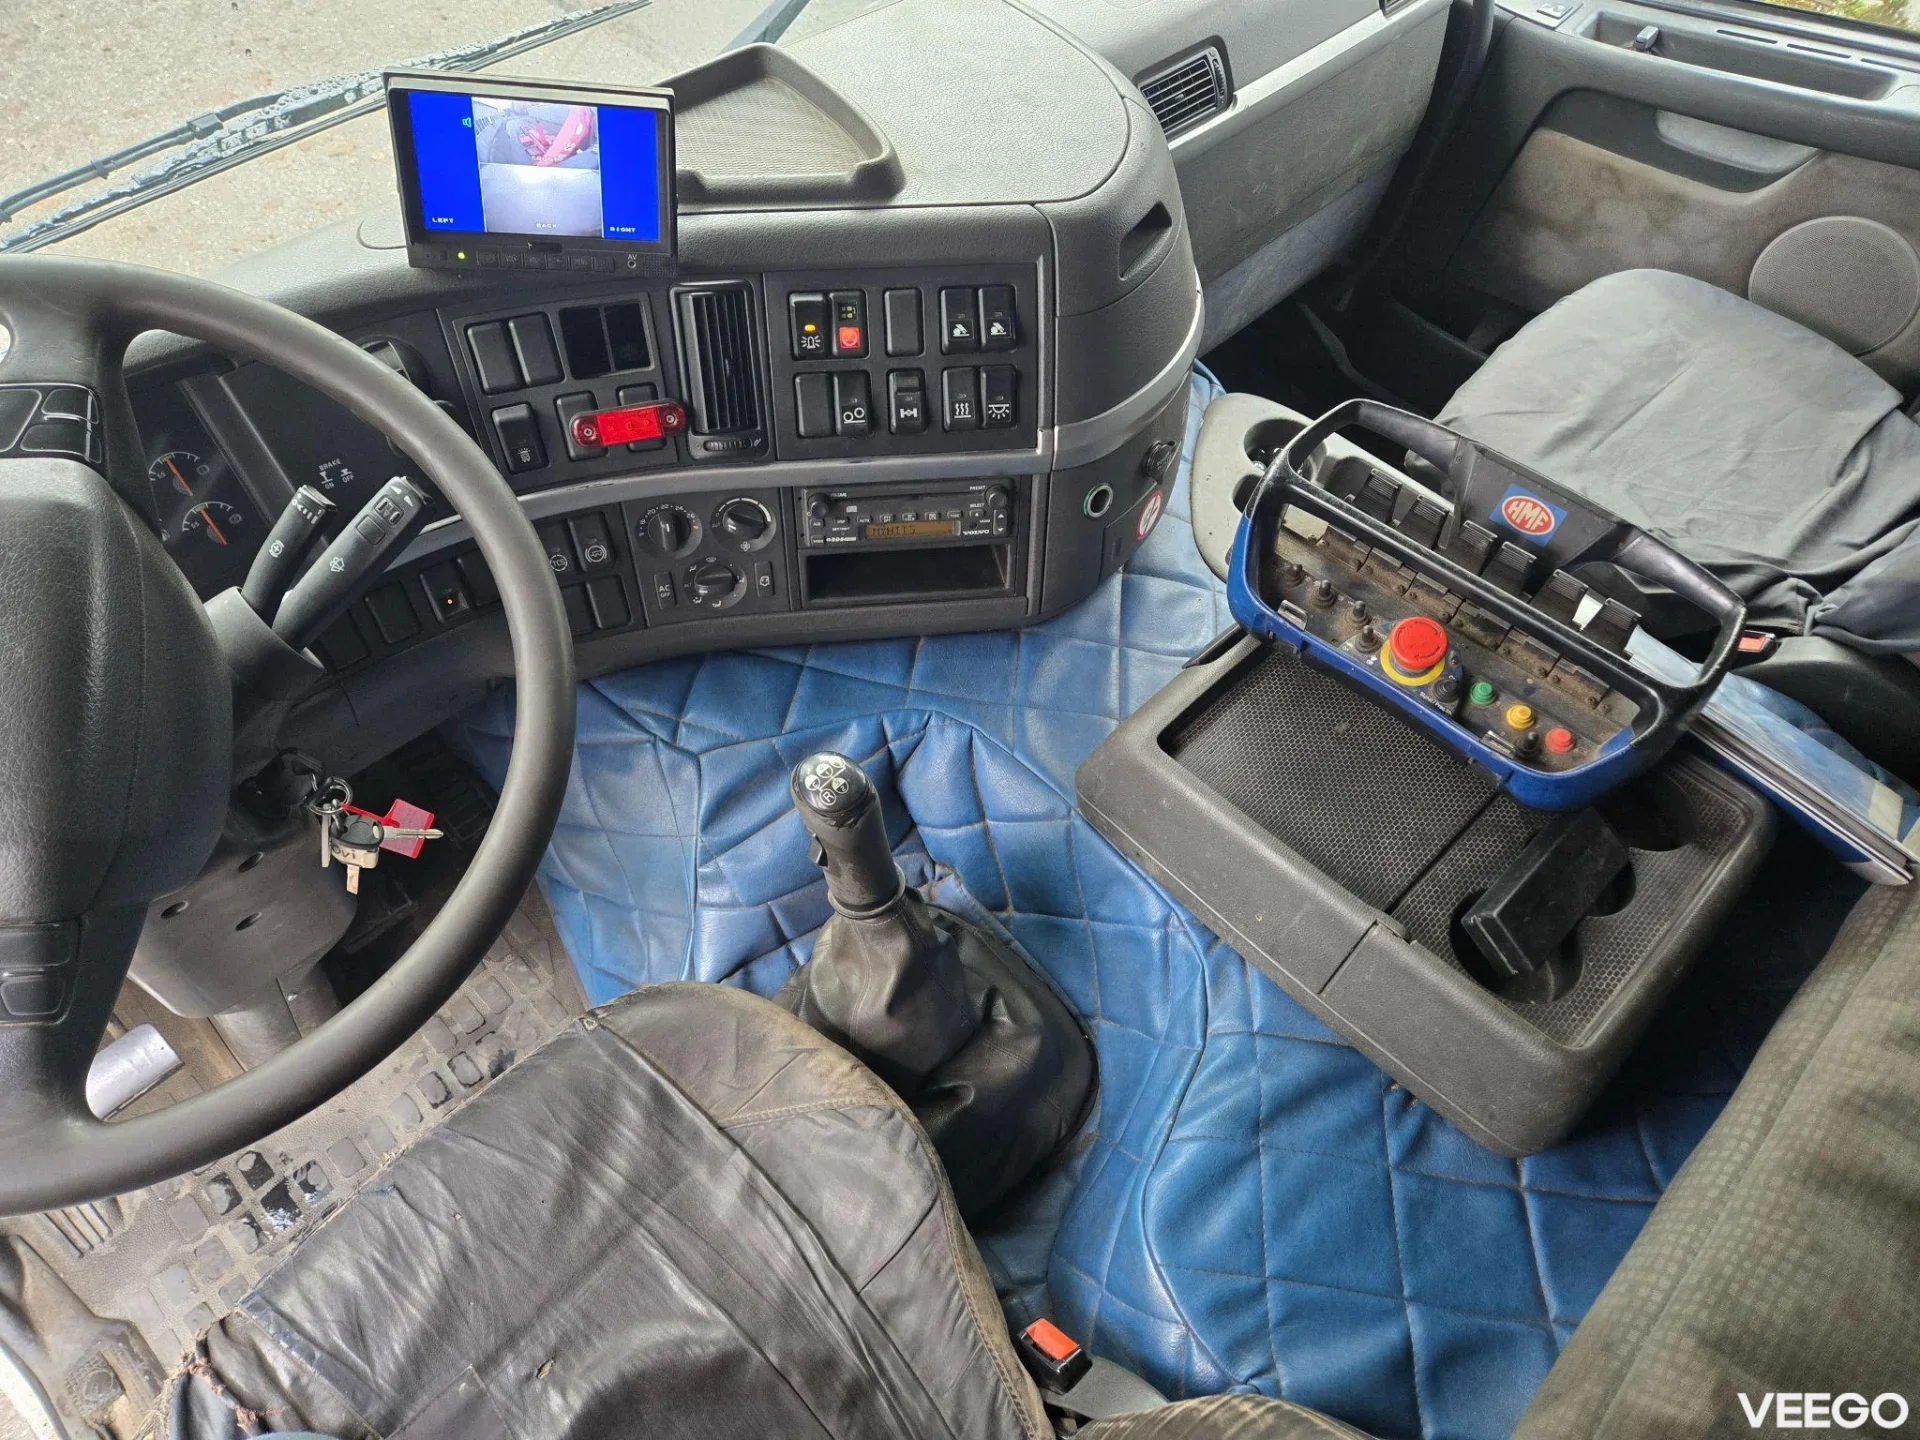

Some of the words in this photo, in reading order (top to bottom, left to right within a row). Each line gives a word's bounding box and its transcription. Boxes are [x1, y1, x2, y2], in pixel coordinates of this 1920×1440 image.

[431, 216, 454, 224] LEFT
[627, 253, 638, 261] AV
[318, 458, 341, 471] BRAKE
[324, 482, 335, 490] ON
[342, 474, 355, 483] OFF
[1506, 500, 1550, 531] HMF
[659, 584, 671, 593] AC
[822, 790, 835, 803] R
